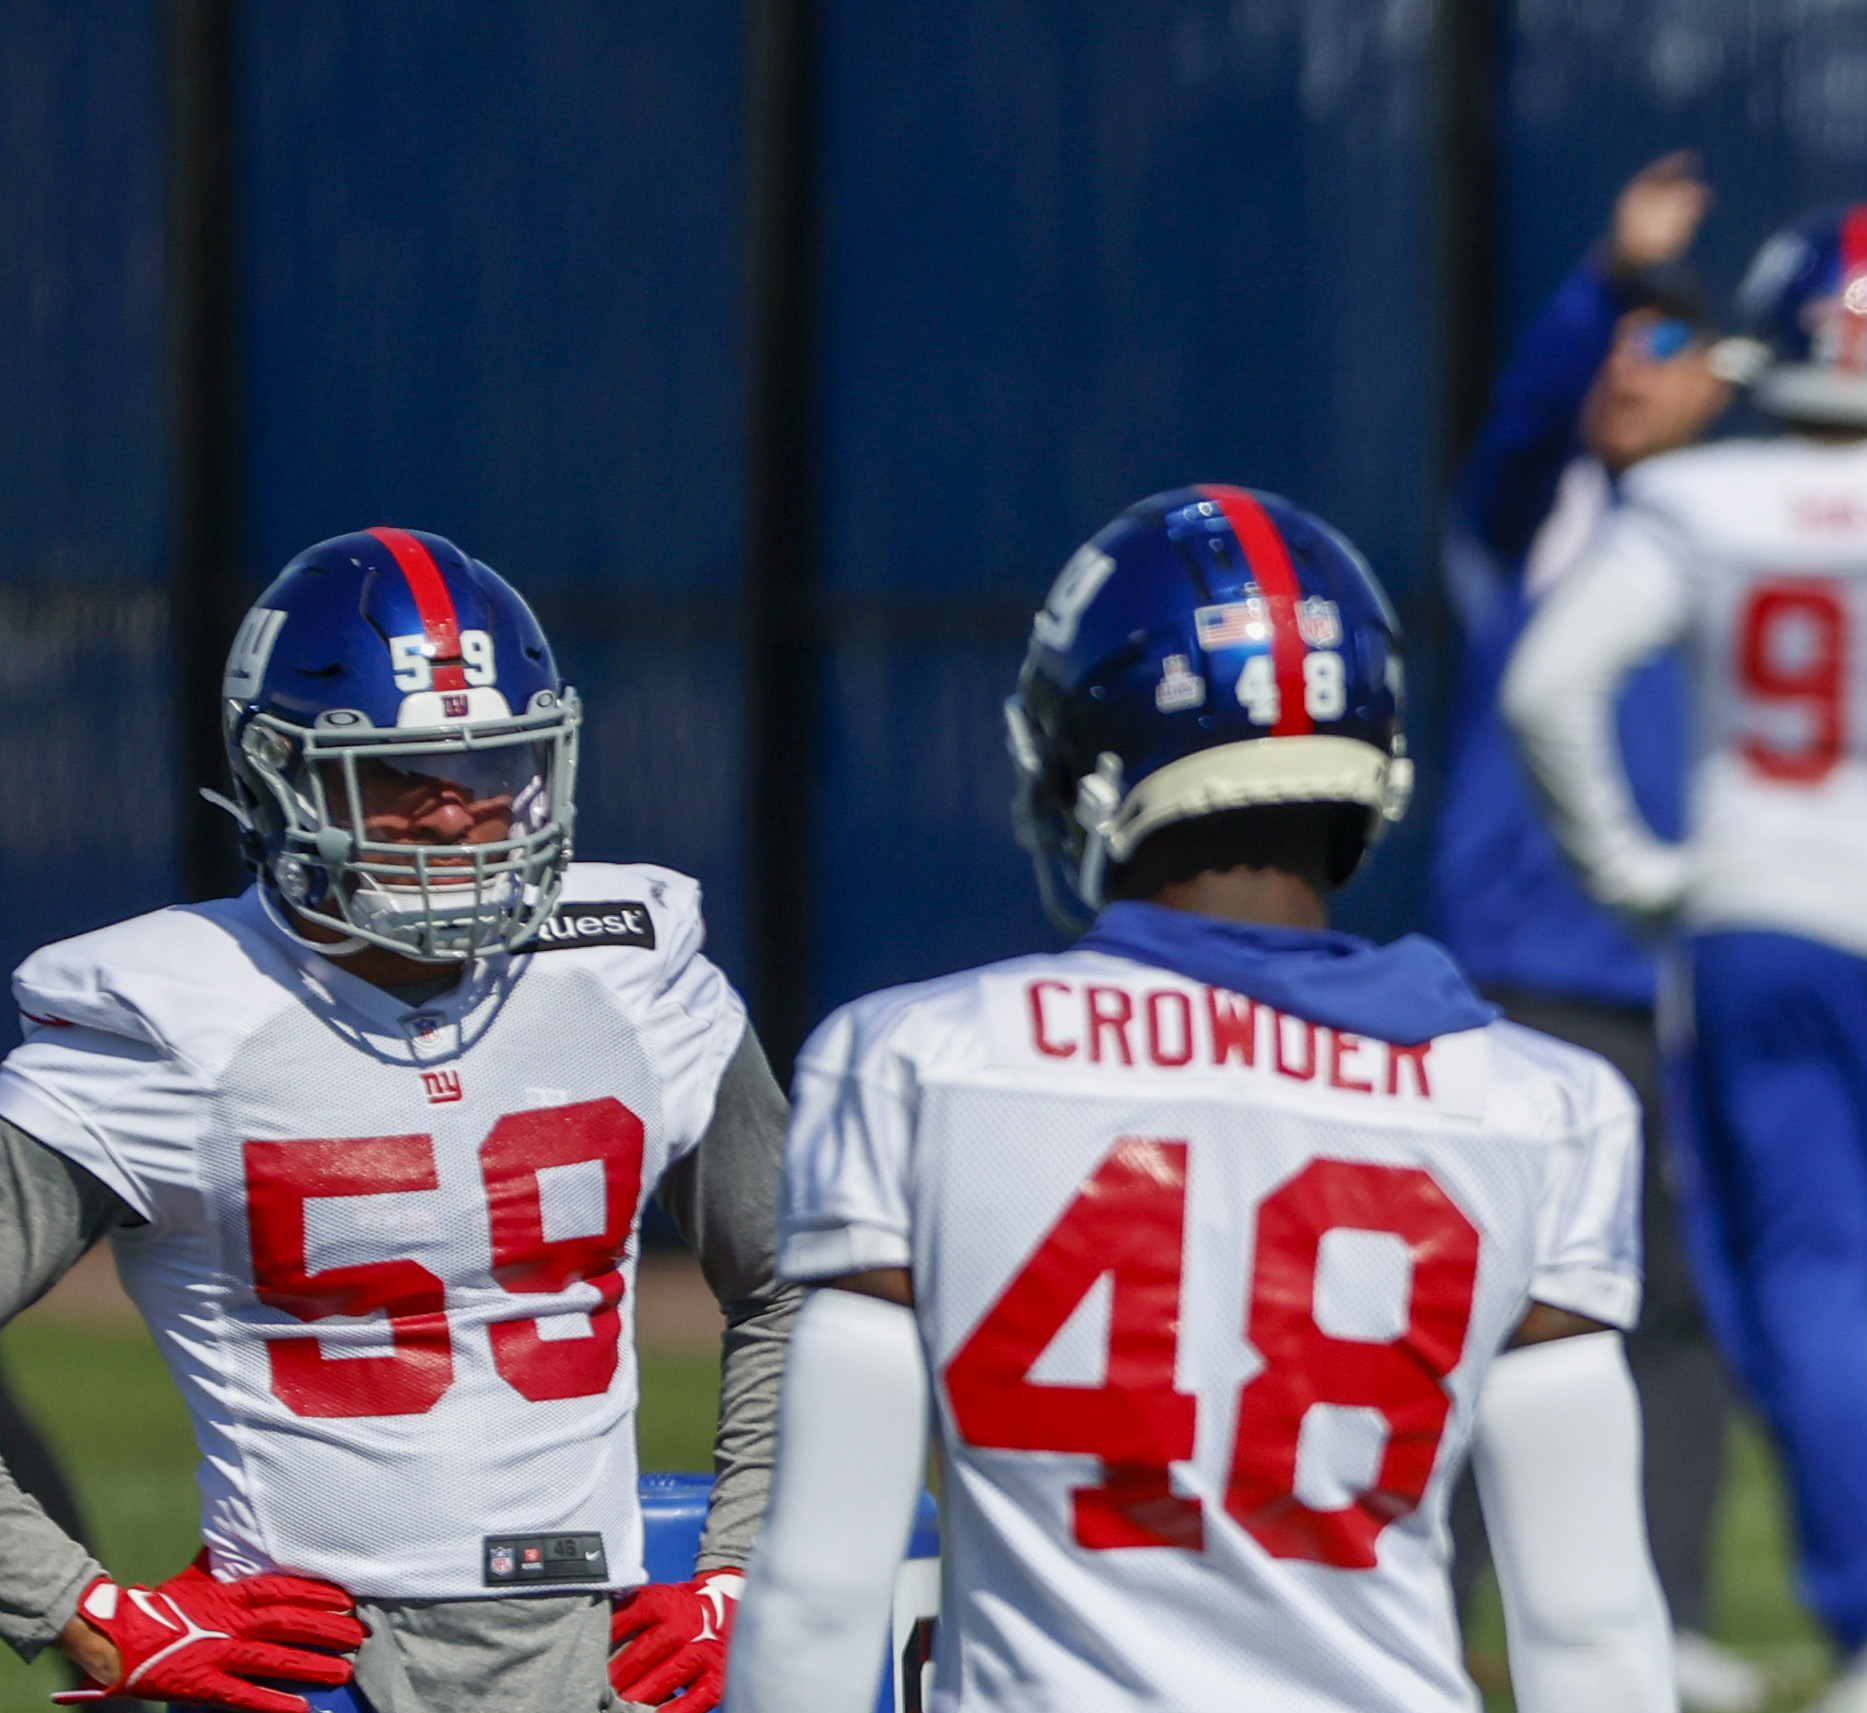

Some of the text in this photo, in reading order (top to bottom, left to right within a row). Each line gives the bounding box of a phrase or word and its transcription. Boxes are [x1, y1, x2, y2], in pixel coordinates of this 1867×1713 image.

[389, 629, 496, 692] 59
[1235, 650, 1347, 726] 48
[419, 1070, 463, 1104] ny
[1022, 980, 1435, 1099] CROWDER
[242, 1096, 645, 1417] 59
[943, 1136, 1480, 1570] 48
